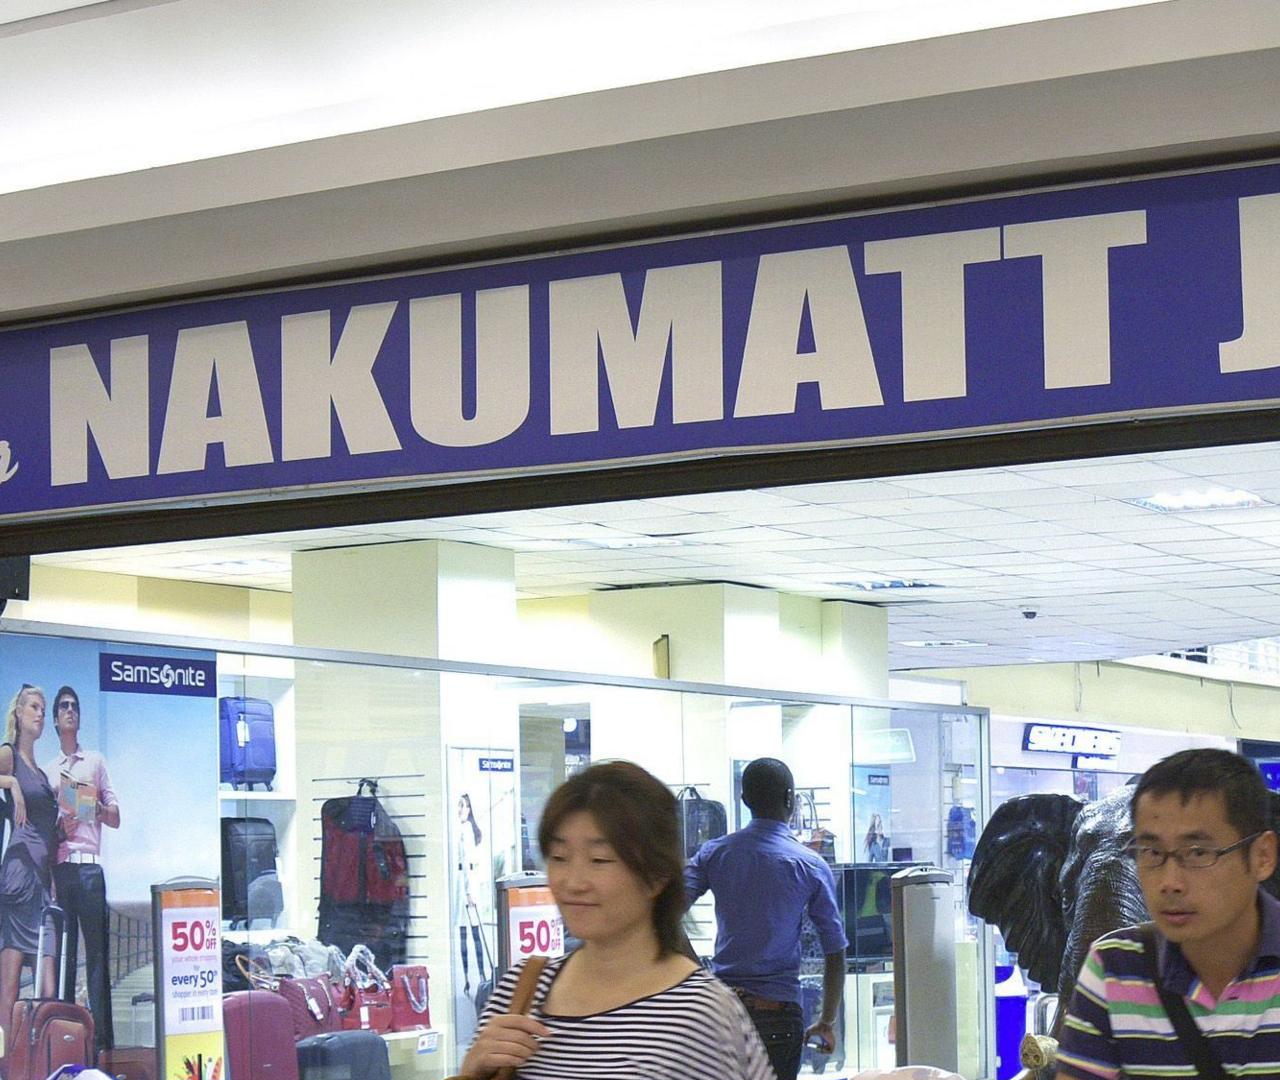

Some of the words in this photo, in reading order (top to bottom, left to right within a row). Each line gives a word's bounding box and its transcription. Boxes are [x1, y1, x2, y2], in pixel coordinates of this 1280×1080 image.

[49, 208, 1147, 487] NAKUMATT
[111, 661, 206, 688] Samsonite
[171, 974, 199, 988] every
